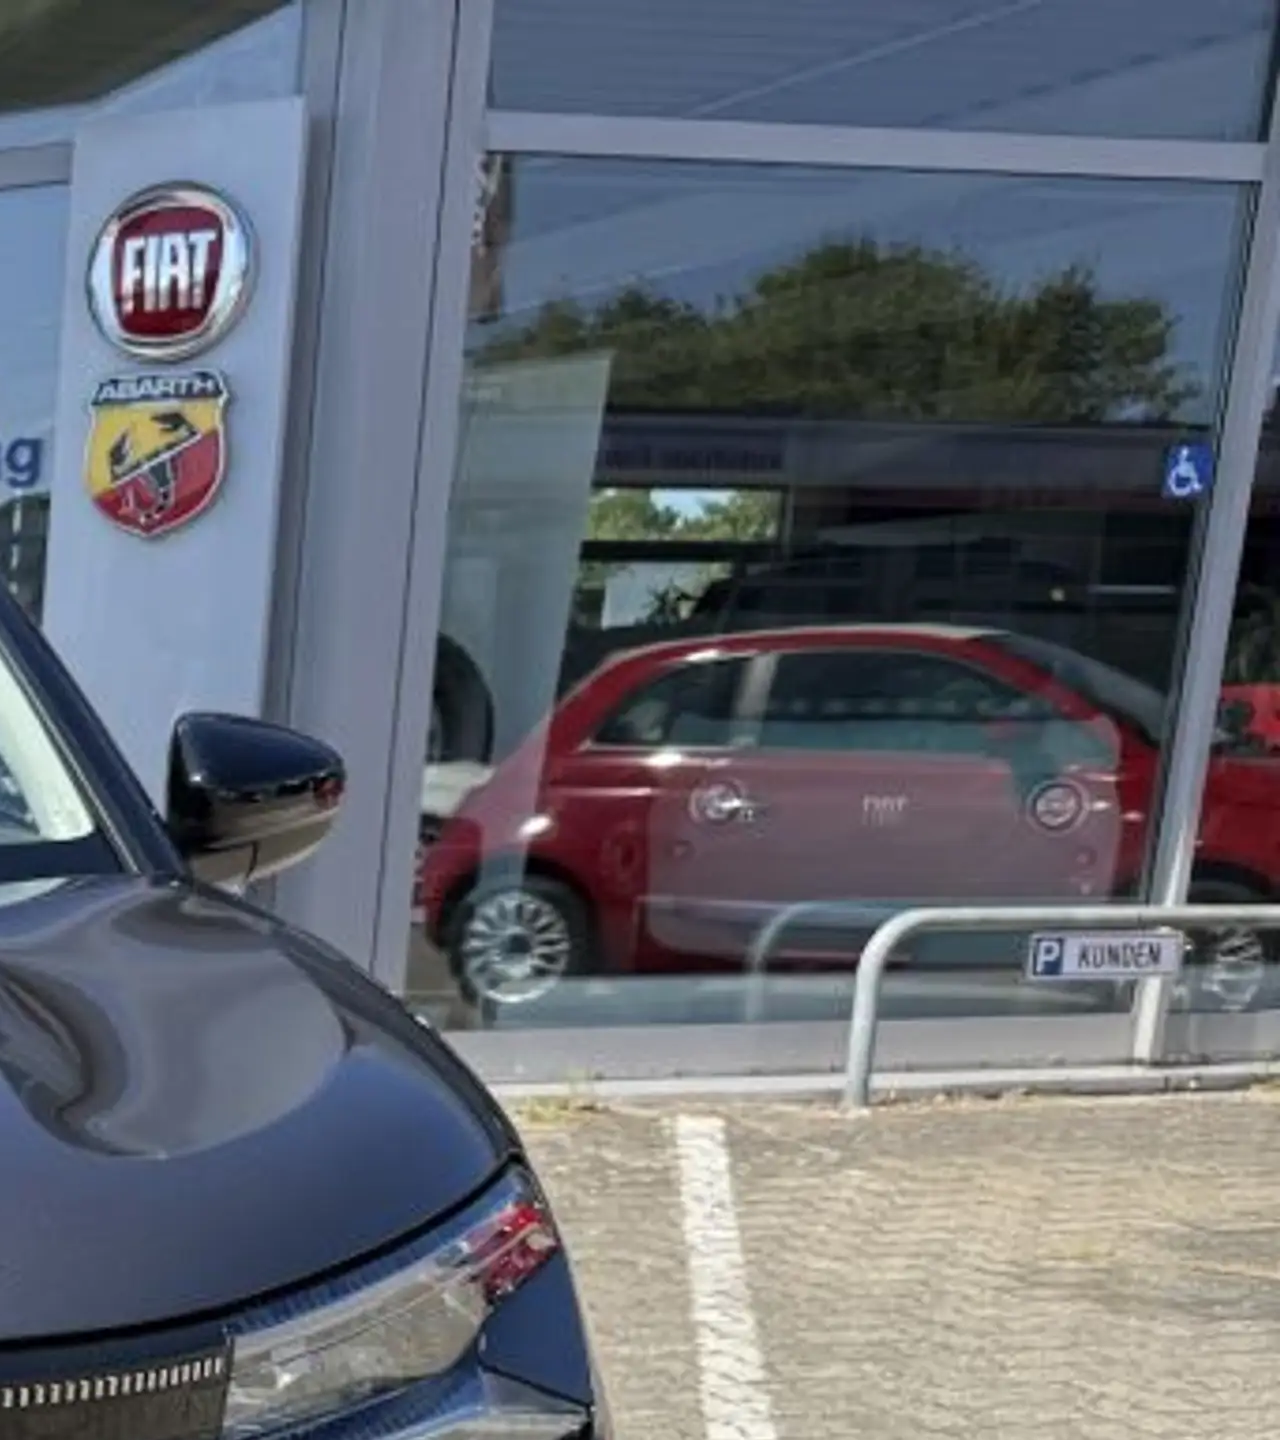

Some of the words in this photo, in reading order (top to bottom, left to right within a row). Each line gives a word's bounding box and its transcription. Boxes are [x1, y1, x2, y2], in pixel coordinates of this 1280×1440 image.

[121, 228, 217, 315] FIAT
[99, 377, 215, 401] ABARTH
[1035, 941, 1060, 972] P
[1077, 941, 1162, 969] KUNDEN
